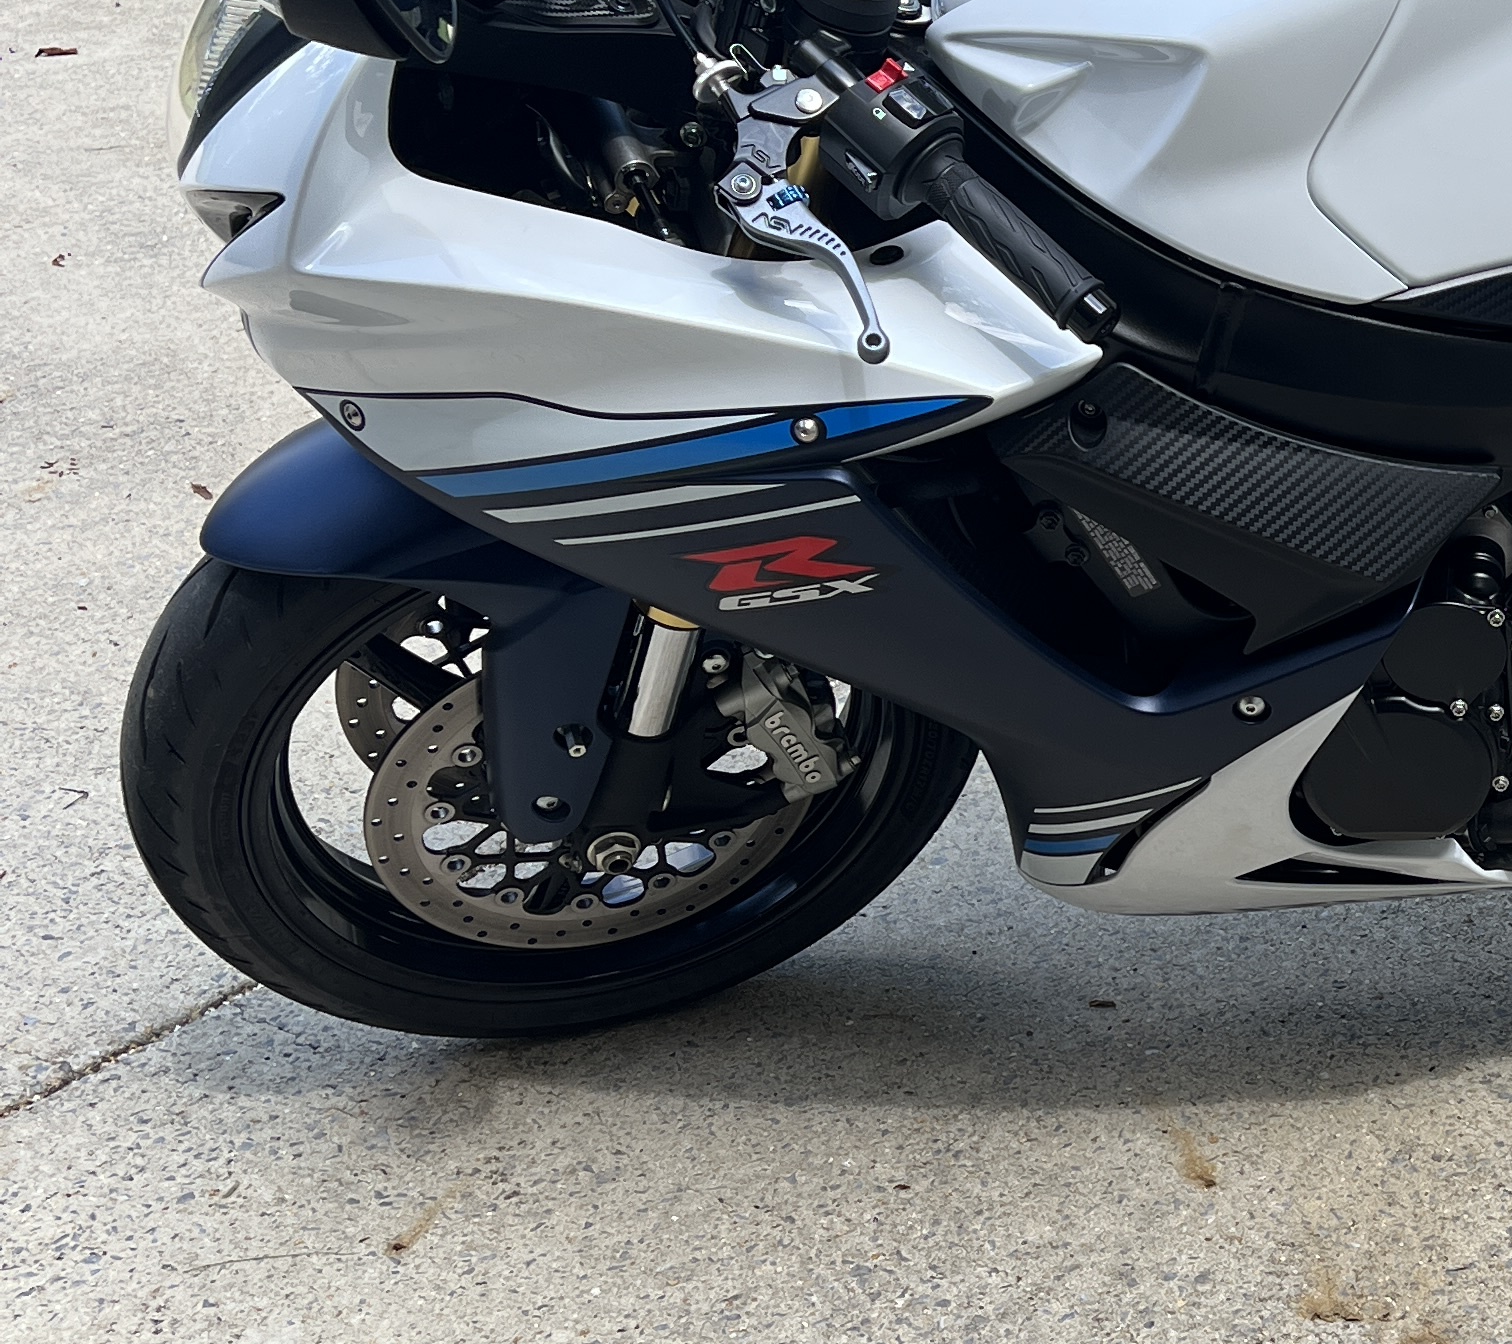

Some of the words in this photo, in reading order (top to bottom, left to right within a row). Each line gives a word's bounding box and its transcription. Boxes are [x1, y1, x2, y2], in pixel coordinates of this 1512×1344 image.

[752, 211, 801, 236] ASV
[683, 535, 876, 592] R
[718, 573, 880, 611] GSX
[765, 711, 822, 784] brembo
